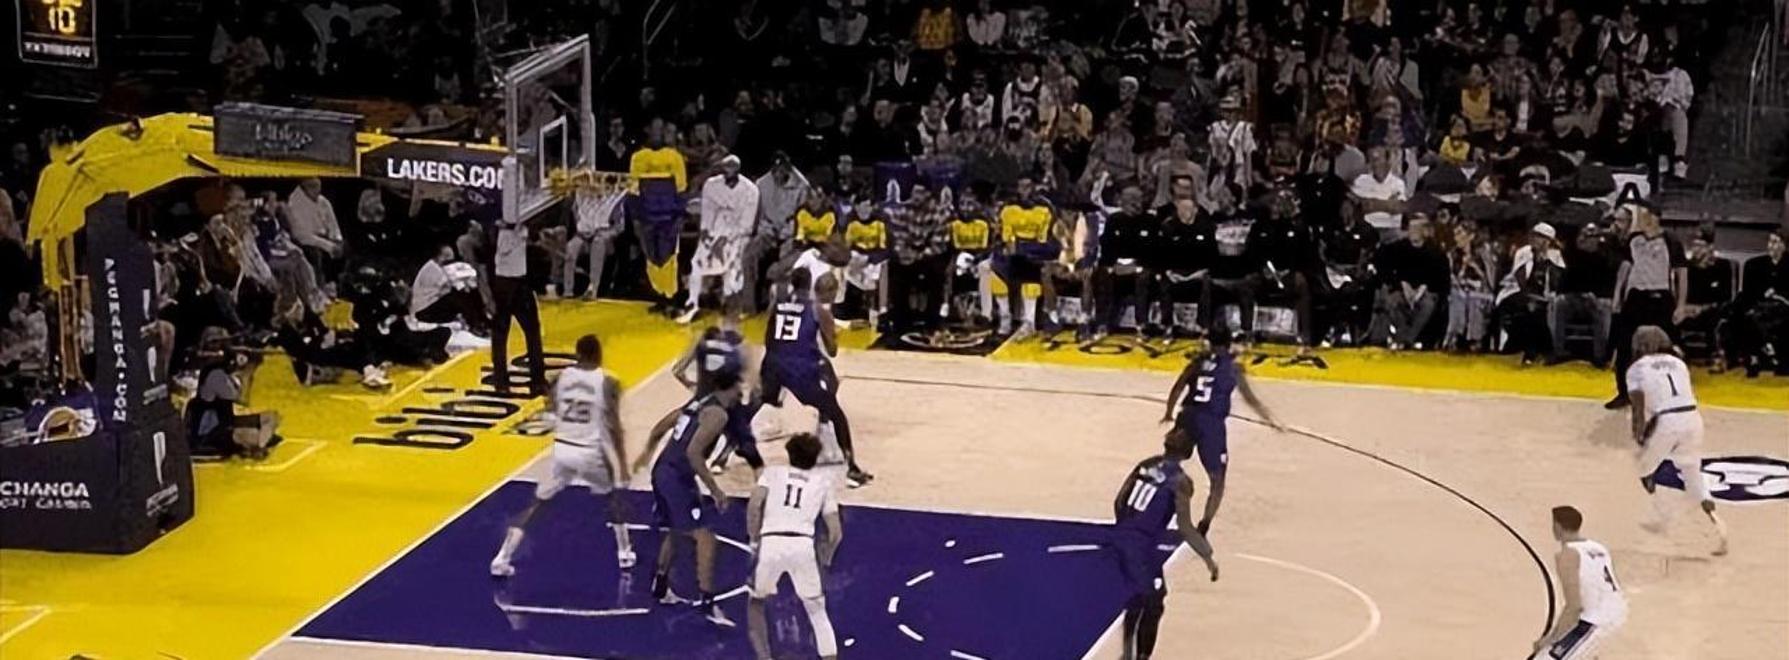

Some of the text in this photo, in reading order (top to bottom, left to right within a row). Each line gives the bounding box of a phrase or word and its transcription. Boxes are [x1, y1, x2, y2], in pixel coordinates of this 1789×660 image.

[775, 313, 802, 340] 13
[1193, 375, 1216, 402] 5
[1666, 372, 1679, 397] 1
[783, 484, 803, 509] 11
[1127, 479, 1157, 512] 10
